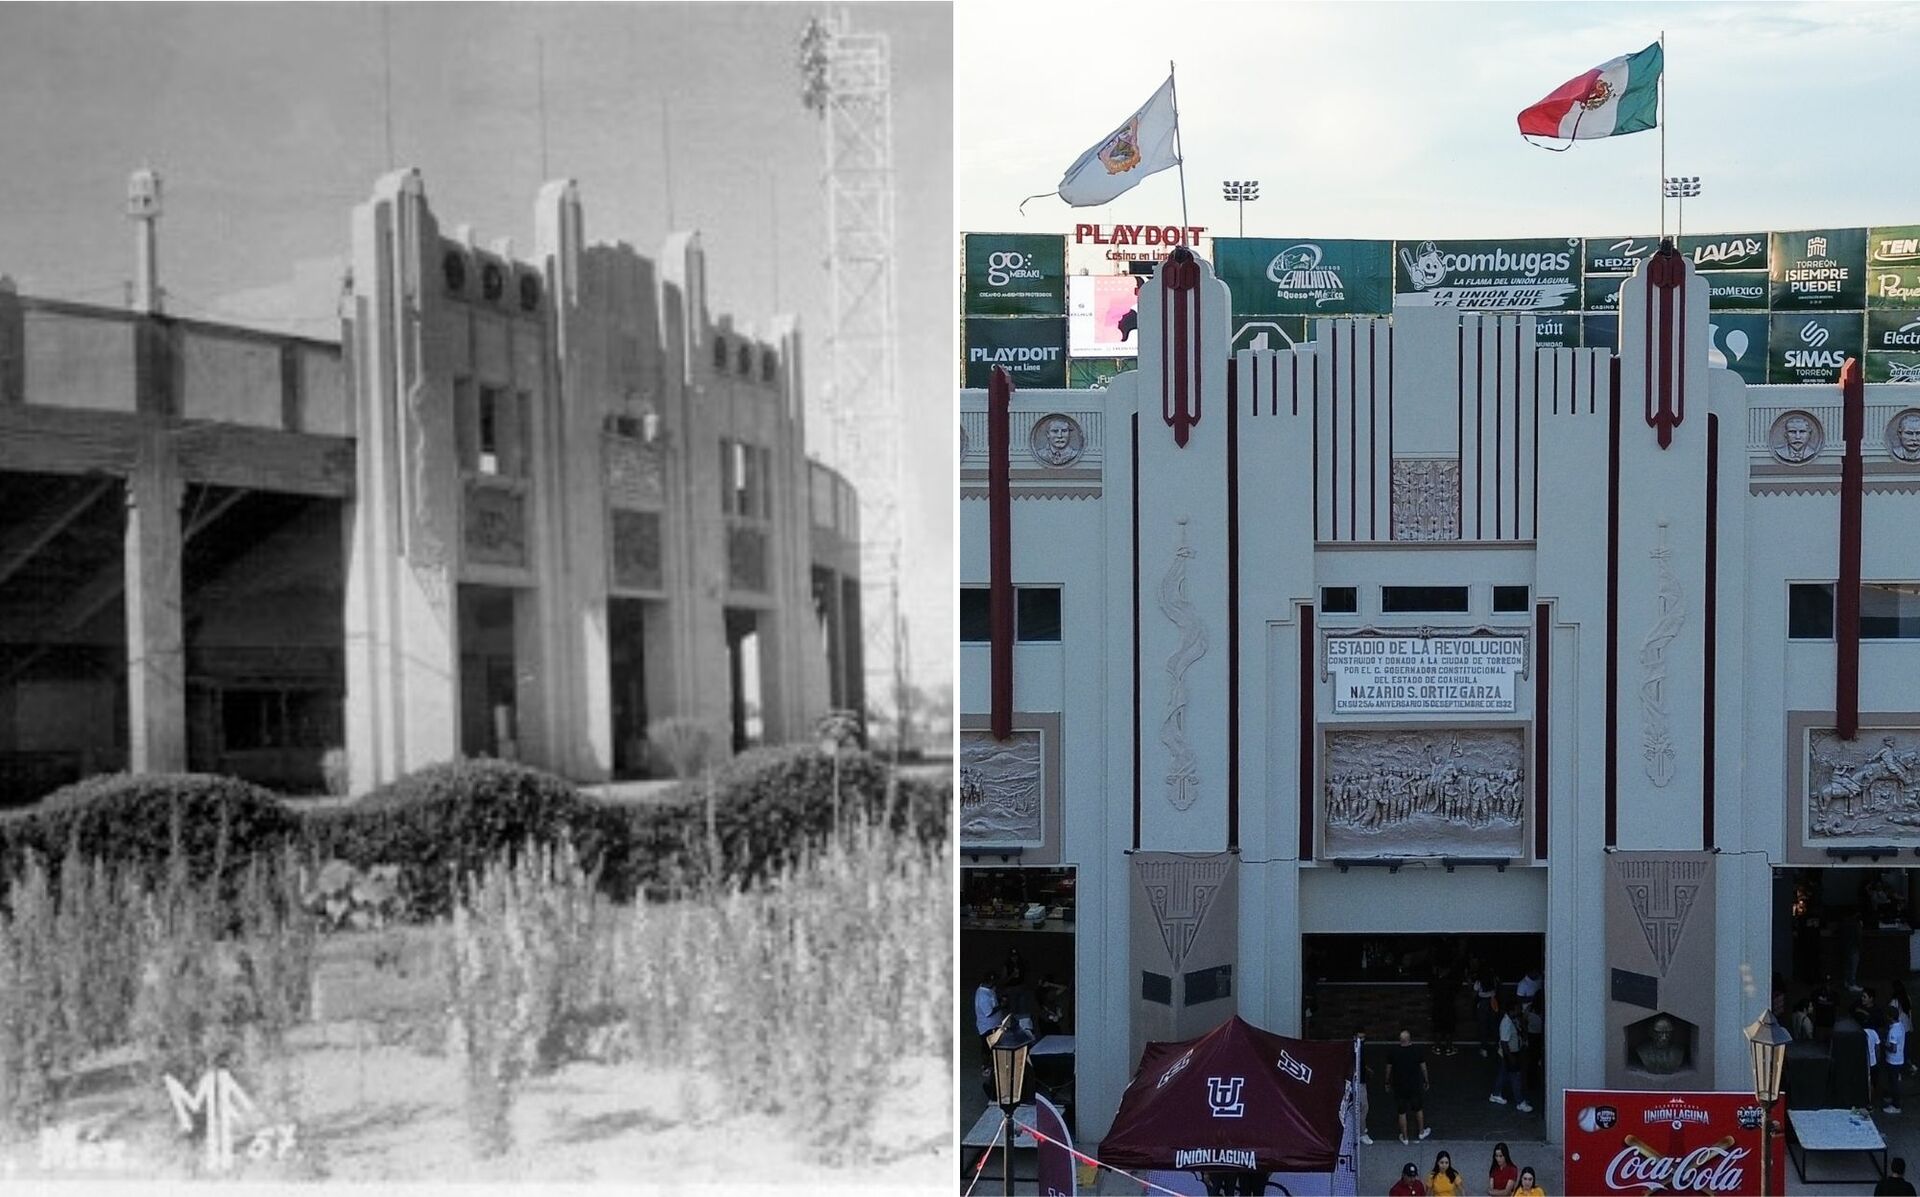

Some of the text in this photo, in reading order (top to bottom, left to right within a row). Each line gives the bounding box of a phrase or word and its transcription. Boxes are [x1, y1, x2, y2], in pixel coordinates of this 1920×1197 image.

[1076, 223, 1205, 246] PLAYDOIT
[1694, 240, 1746, 265] LALA
[1880, 239, 1918, 254] TEN
[1106, 249, 1137, 261] Casino
[1139, 252, 1150, 261] en
[1443, 248, 1570, 277] combugas
[1796, 259, 1837, 268] TORREÓN
[988, 252, 1024, 287] go
[1009, 269, 1040, 278] MERAKI
[1785, 268, 1849, 282] ¡SIEMPRE
[1278, 270, 1344, 289] CHILCHOTA
[1454, 278, 1465, 286] LA
[1511, 276, 1536, 285] UNIÓN
[1708, 286, 1763, 297] EROMEXICO
[1791, 280, 1841, 293] PUEDE!
[1283, 291, 1309, 300] Queso
[1433, 289, 1545, 299] LA UNIÓN QUE
[1456, 297, 1542, 308] ENCIENDE
[1536, 318, 1563, 335] eón
[970, 347, 1060, 362] PLAYDOIT
[1796, 368, 1833, 377] TORREÓN
[1329, 639, 1522, 655] ESTADIO DE LA REVOLUCION
[1328, 656, 1522, 665] CONSTRUIDO Y DONADO A LA CIUDAD DE TORREON
[1344, 666, 1360, 674] POR
[1361, 666, 1371, 674] EL
[1384, 666, 1437, 674] GOBERNADOR
[1438, 666, 1506, 674] CONSTITUCIONAL
[1374, 676, 1478, 684] DEL ESTADO DE COAHUILA
[1350, 686, 1502, 699] NAZARIO S. ORTIZ GARZA
[1337, 700, 1347, 708] EN
[1347, 700, 1358, 708] SU
[1376, 700, 1422, 708] ANIVERSARIO
[1430, 700, 1439, 708] DE
[1439, 700, 1485, 708] SEPTIEMBRE
[1485, 700, 1496, 708] DE
[1673, 1108, 1710, 1125] LAGUNA
[1175, 1148, 1257, 1170] UNIÓN LAGUNA
[1605, 1145, 1752, 1191] Coca-Cola
